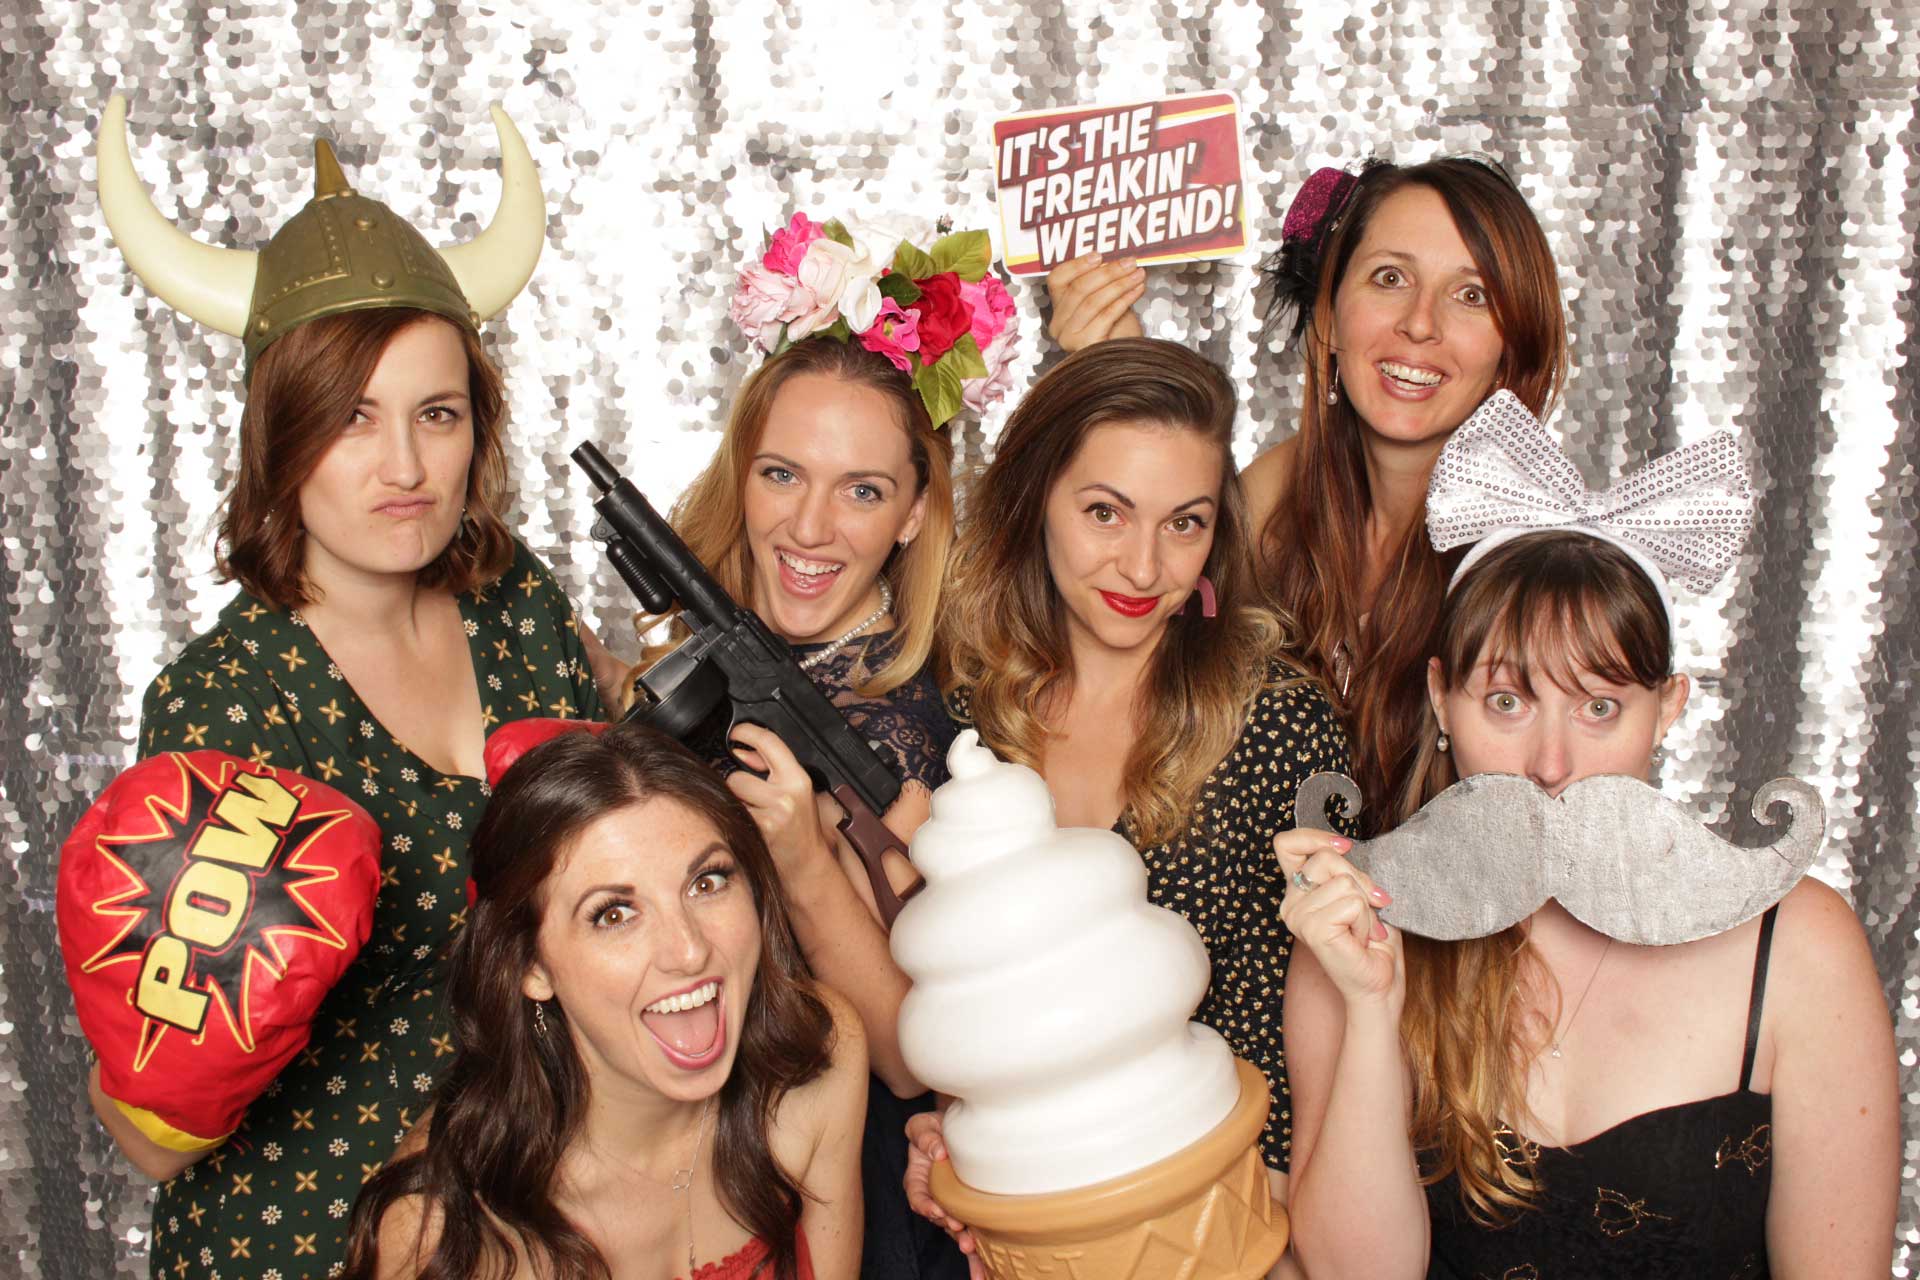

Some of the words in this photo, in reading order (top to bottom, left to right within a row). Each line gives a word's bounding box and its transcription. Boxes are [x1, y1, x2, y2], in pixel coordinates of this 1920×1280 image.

[1001, 124, 1071, 181] IT'S
[1079, 105, 1154, 163] THE
[1023, 142, 1198, 224] FREAKIN'
[1039, 184, 1238, 266] WEEKEND!
[134, 770, 301, 1033] POW
